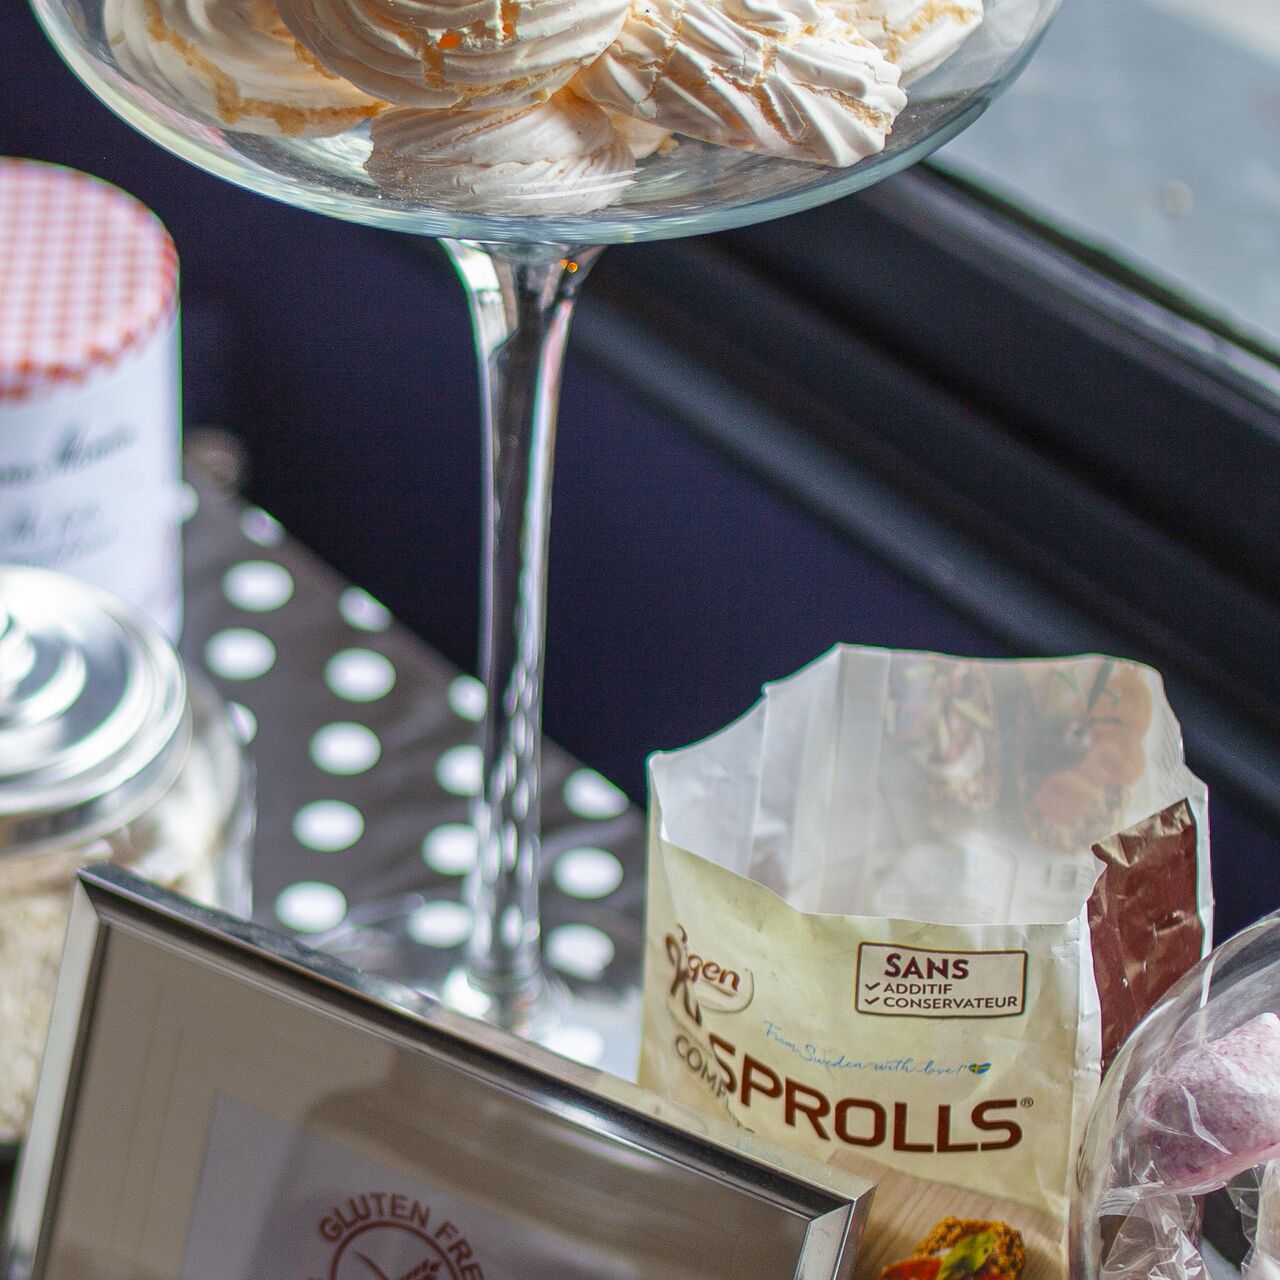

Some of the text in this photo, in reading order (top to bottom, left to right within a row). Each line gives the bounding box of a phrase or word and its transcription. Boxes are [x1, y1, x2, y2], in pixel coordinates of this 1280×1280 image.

[884, 953, 969, 980] SANS
[883, 982, 953, 995] ADDITIF
[883, 996, 1018, 1009] CONSERVATEUR
[800, 1044, 868, 1070] Sweden
[874, 1056, 916, 1073] with
[318, 1192, 431, 1243] GLUTEN
